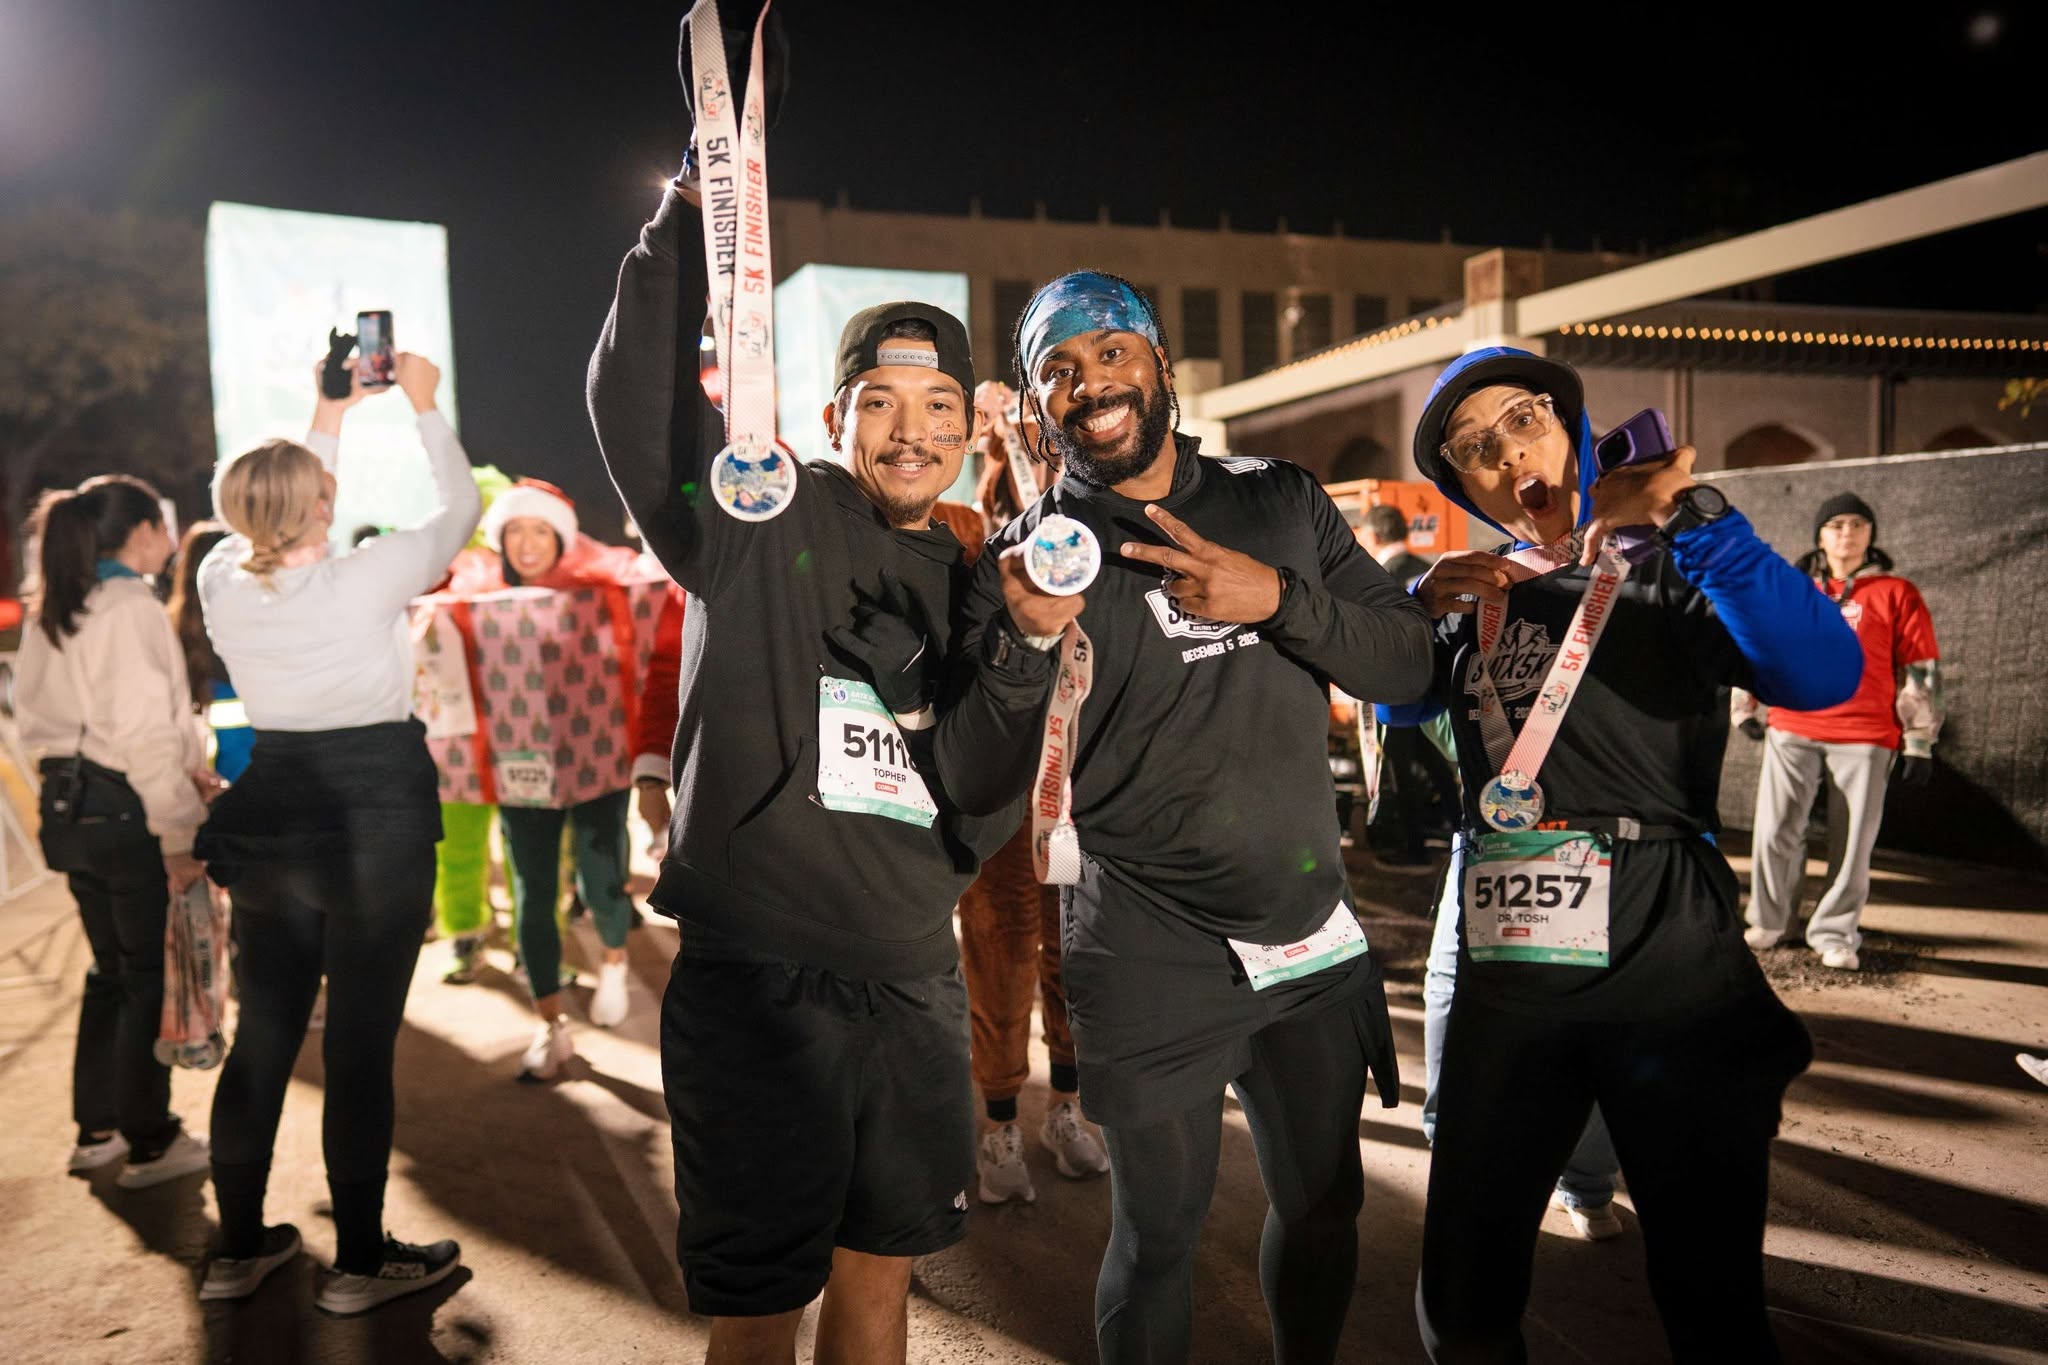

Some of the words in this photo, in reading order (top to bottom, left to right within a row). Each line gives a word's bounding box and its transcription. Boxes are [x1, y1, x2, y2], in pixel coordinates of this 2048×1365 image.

[706, 136, 731, 168] 5K
[744, 158, 764, 257] FINISHER
[709, 176, 737, 276] FINISHER
[742, 266, 766, 294] 5K
[1572, 572, 1618, 645] FINISHER
[1074, 640, 1089, 663] 5K
[1181, 641, 1226, 664] DECEMBER
[1226, 639, 1235, 651] 5
[1237, 631, 1260, 648] 2025
[1560, 649, 1585, 672] 5K
[1049, 715, 1064, 741] 5K
[843, 723, 917, 770] 5111
[873, 767, 907, 783] TOPHER
[1039, 744, 1063, 820] FINISHER
[1475, 874, 1592, 909] 51257
[1498, 913, 1514, 923] DR.
[1517, 914, 1549, 924] TOSH
